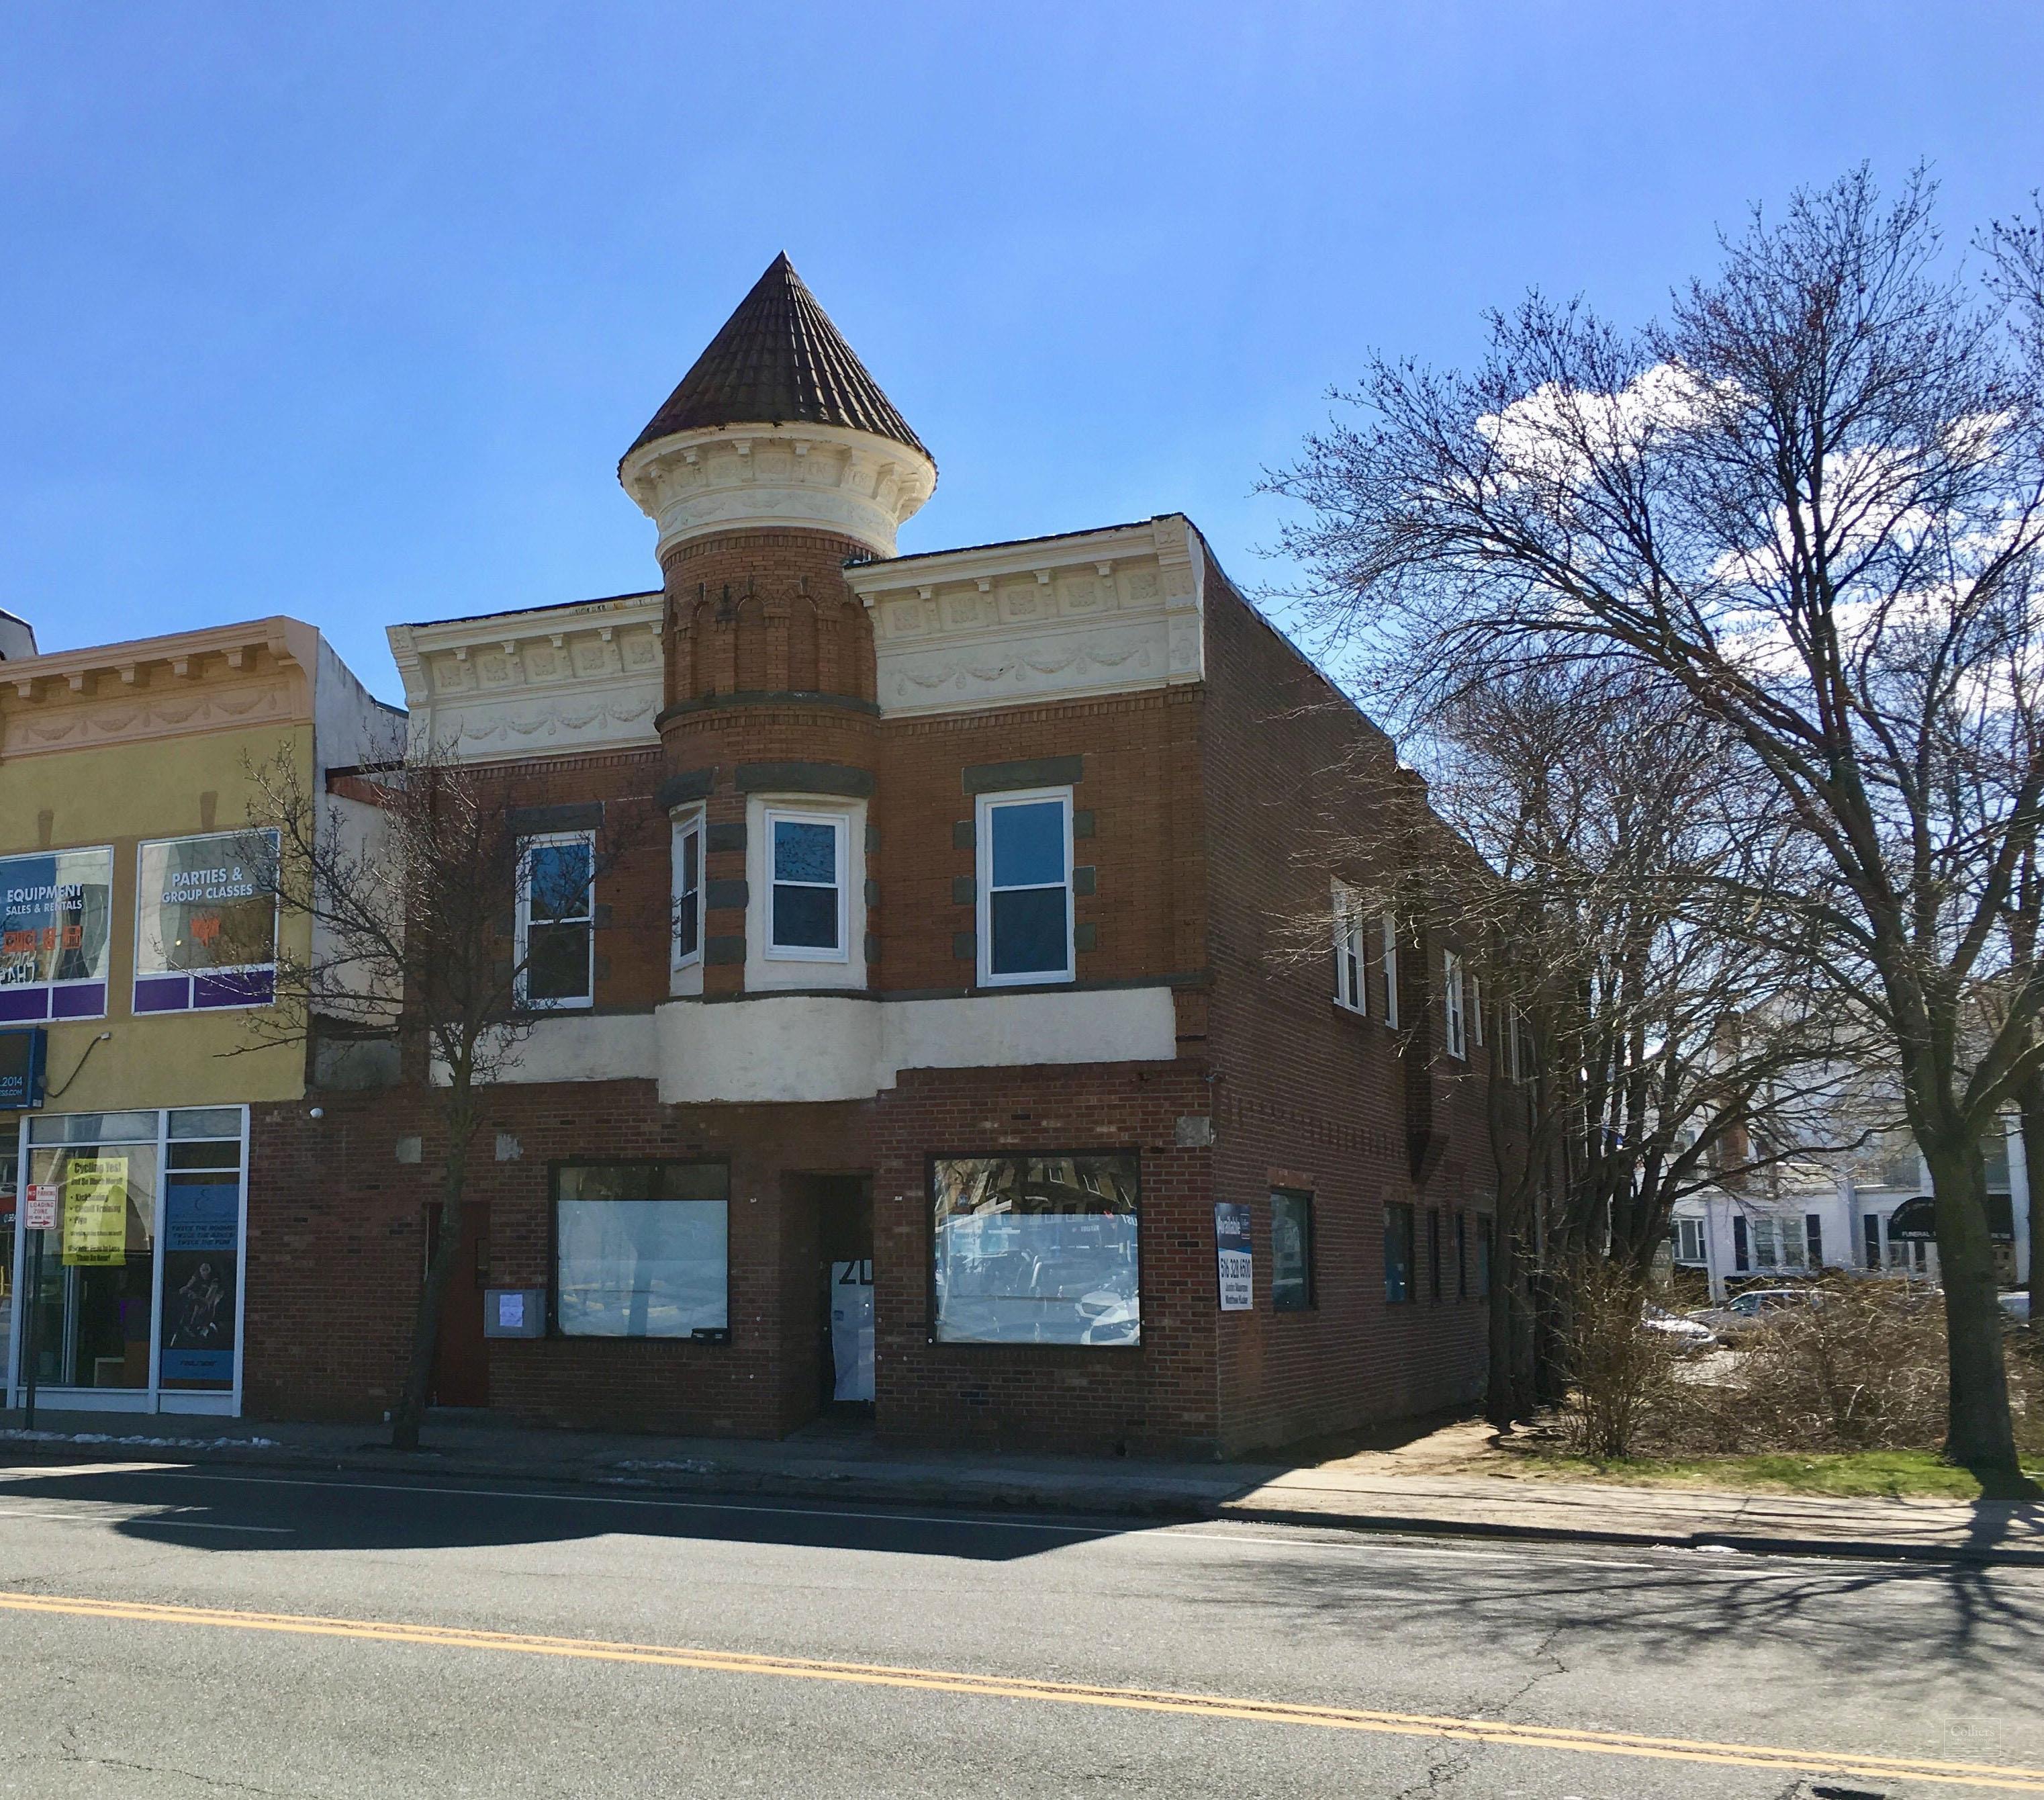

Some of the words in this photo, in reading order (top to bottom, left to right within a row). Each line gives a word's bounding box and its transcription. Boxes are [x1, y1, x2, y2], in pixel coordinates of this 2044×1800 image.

[172, 868, 227, 887] PARTIES
[232, 866, 242, 881] &
[7, 884, 83, 903] EQUIPMENT
[162, 889, 202, 903] GROUP
[205, 884, 253, 899] CLASSES
[6, 904, 31, 916] SALES
[34, 903, 41, 913] &
[44, 899, 83, 912] RENTALS
[75, 1163, 103, 1174] Cycling
